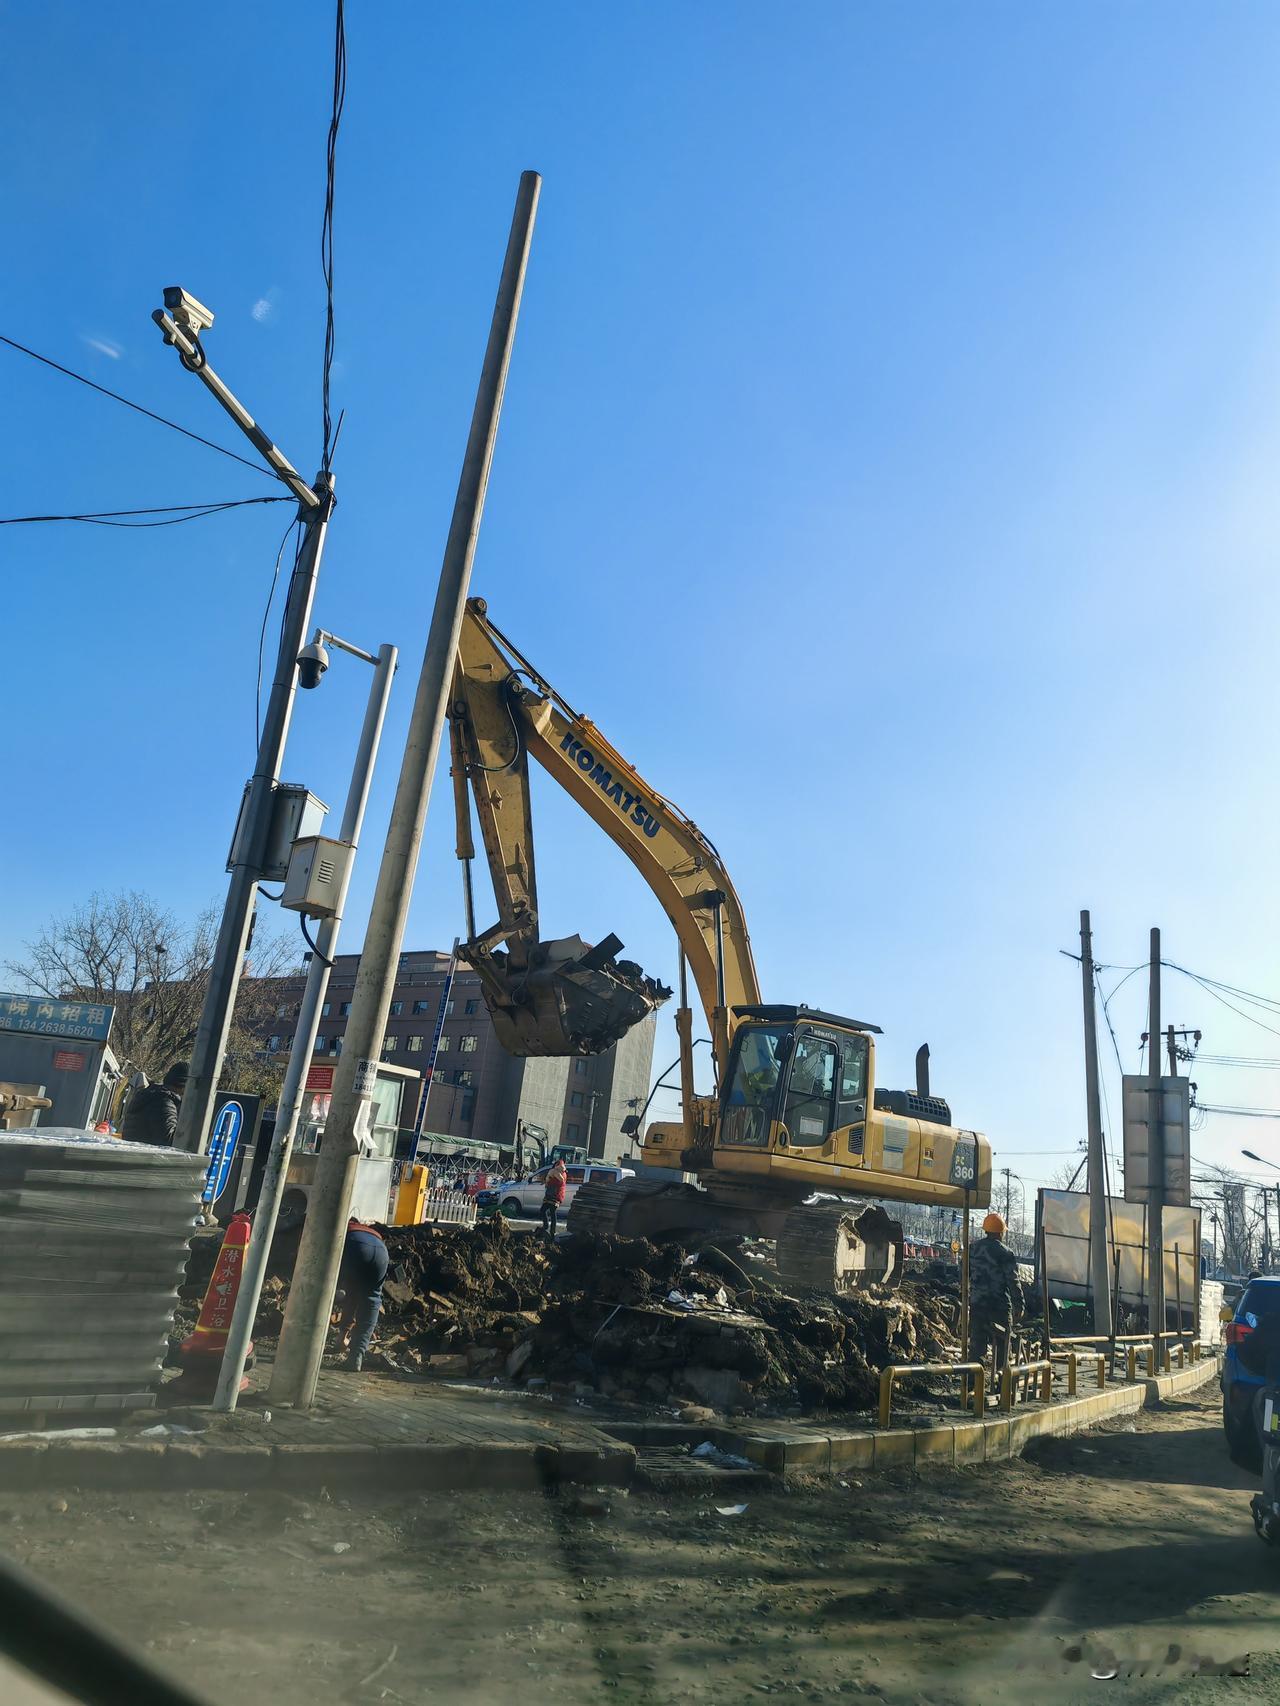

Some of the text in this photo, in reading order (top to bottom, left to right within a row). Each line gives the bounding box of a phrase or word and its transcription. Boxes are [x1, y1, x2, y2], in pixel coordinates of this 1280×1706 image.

[560, 732, 662, 838] KOMATSU
[18, 1018, 37, 1031] 134
[38, 1020, 66, 1033] 2638
[67, 1024, 94, 1037] 5620
[954, 1165, 974, 1180] 360
